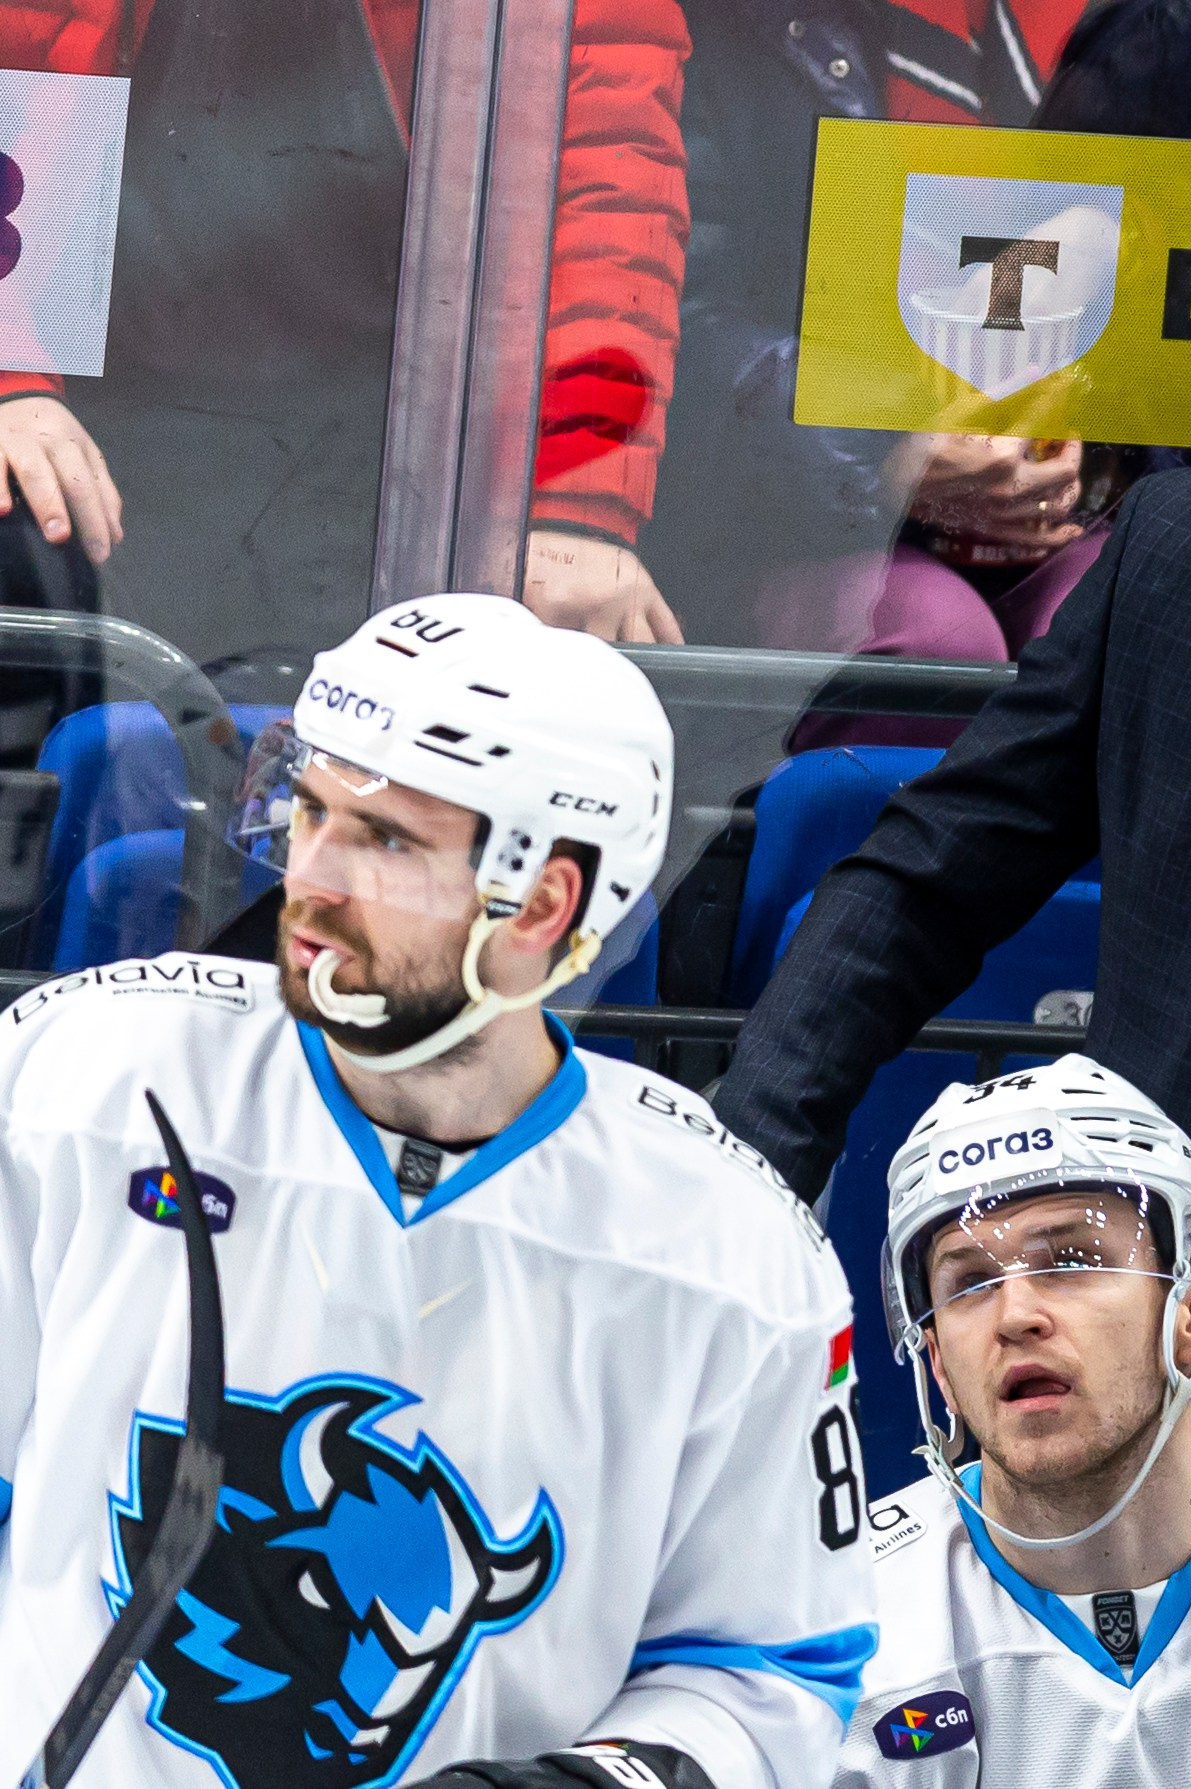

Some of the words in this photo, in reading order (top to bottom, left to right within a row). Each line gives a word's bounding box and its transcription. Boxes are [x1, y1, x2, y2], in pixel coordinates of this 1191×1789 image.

[549, 791, 619, 816] CCM
[939, 1127, 1054, 1174] согаз
[874, 1523, 922, 1554] Airlines
[935, 1706, 969, 1729] сбп
